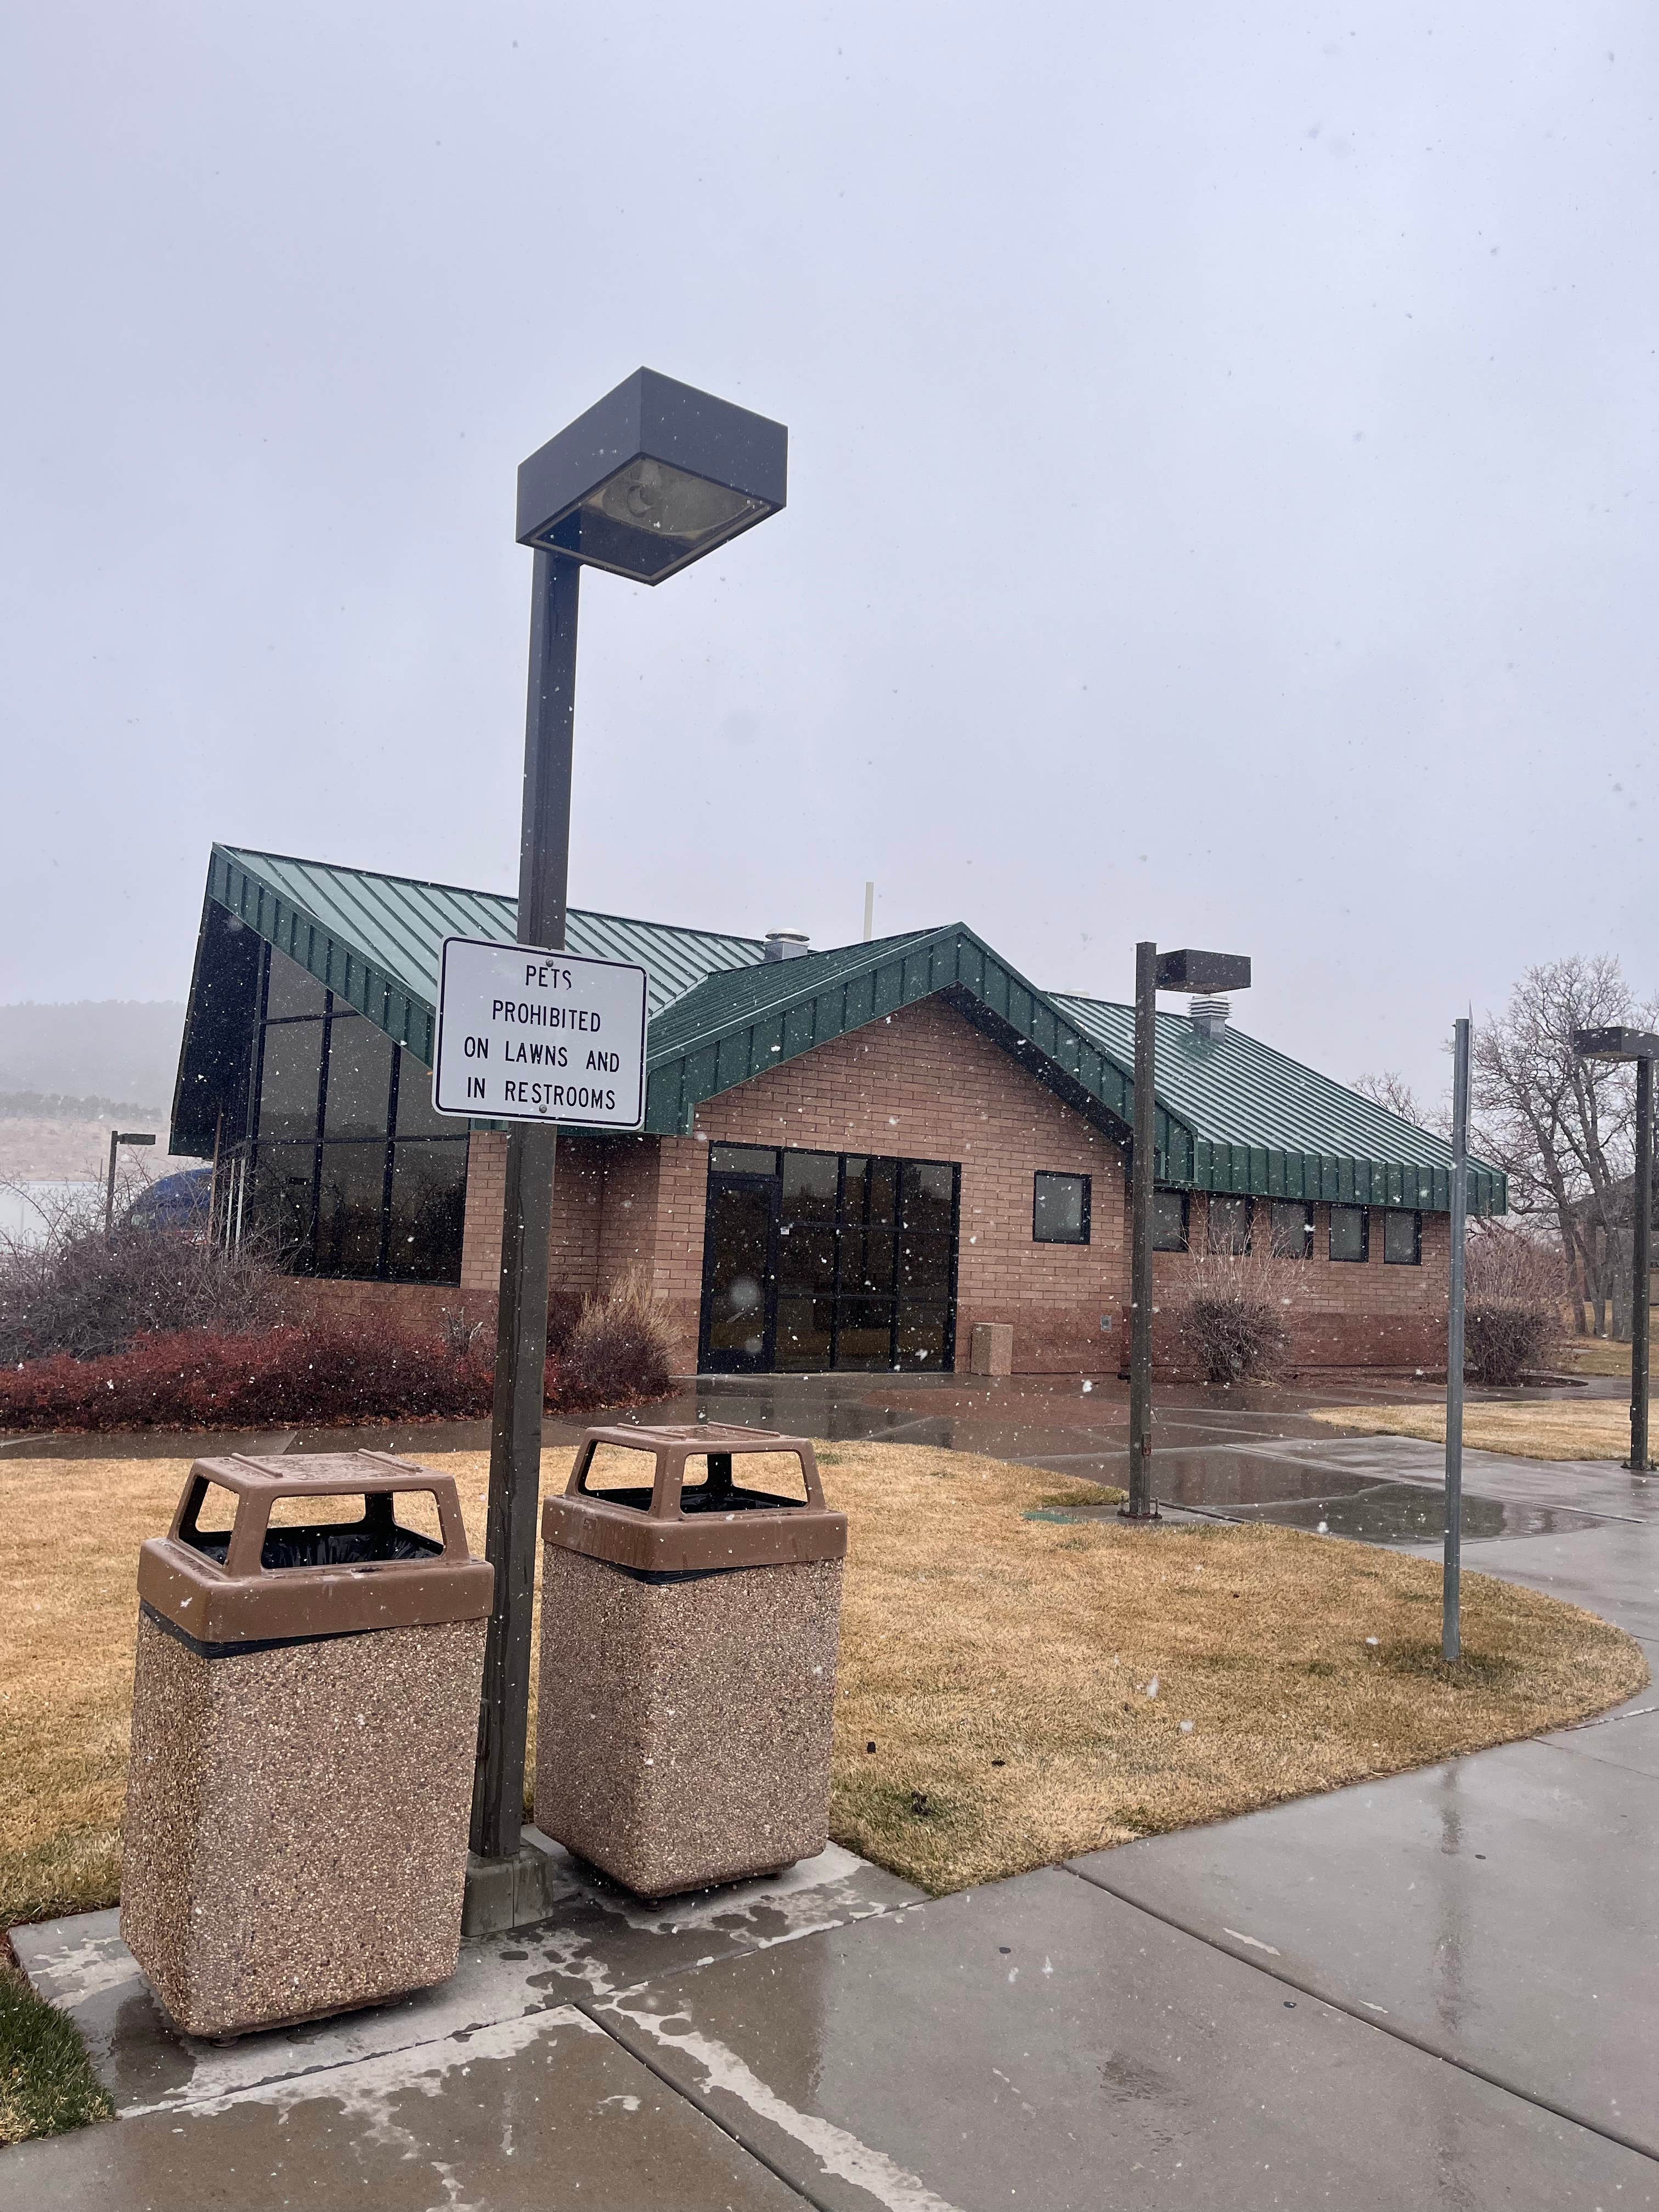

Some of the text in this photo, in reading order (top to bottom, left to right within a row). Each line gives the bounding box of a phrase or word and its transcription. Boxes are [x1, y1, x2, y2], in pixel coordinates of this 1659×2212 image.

[526, 965, 572, 990] PETS
[493, 1000, 601, 1032] PROHIBITED
[464, 1036, 619, 1073] ON LAWNS AND
[467, 1077, 615, 1110] IN RESTROOMS
